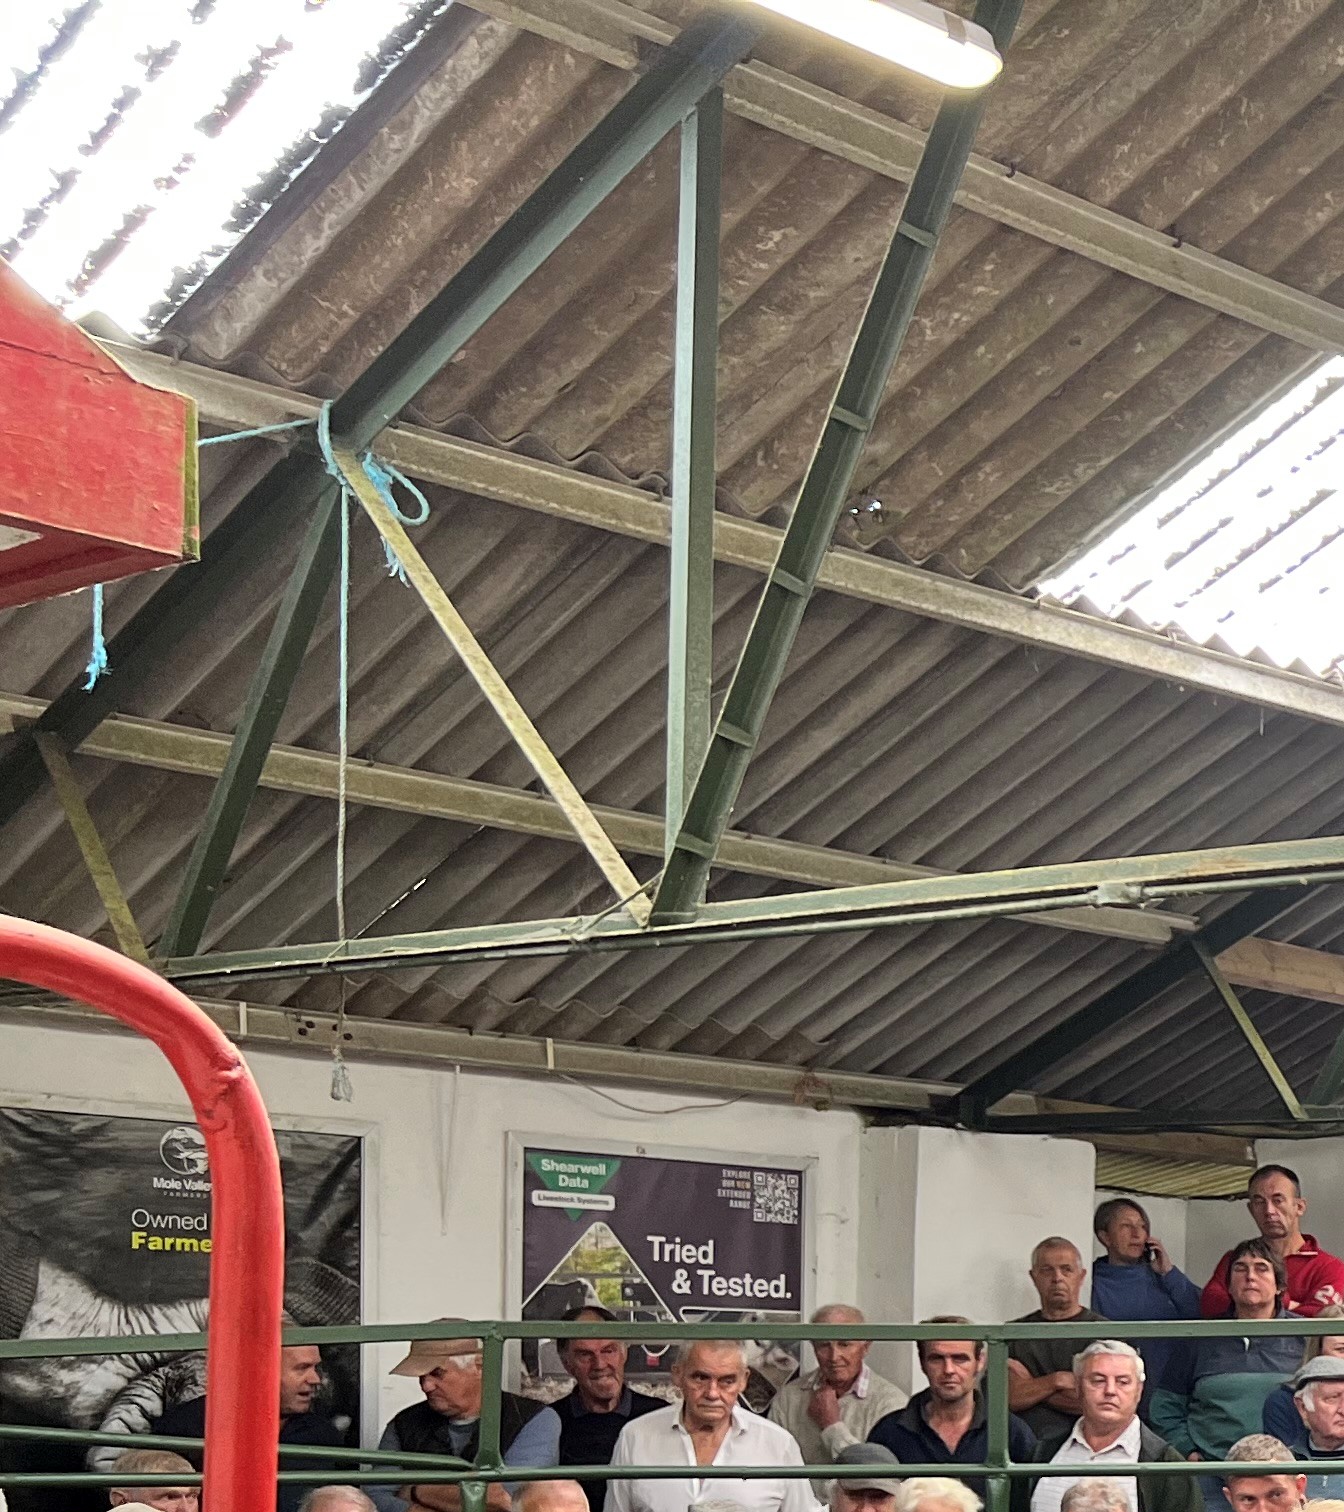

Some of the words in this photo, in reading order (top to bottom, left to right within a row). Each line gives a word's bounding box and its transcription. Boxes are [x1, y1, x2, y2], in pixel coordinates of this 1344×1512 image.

[541, 1158, 607, 1176] Shearwell
[152, 1177, 182, 1190] Mole
[182, 1179, 213, 1192] Valle
[558, 1174, 590, 1189] Data
[131, 1208, 208, 1231] Owned
[131, 1231, 212, 1253] Farme
[646, 1234, 715, 1265] Tried
[671, 1268, 692, 1295] &
[696, 1269, 792, 1299] Tested.
